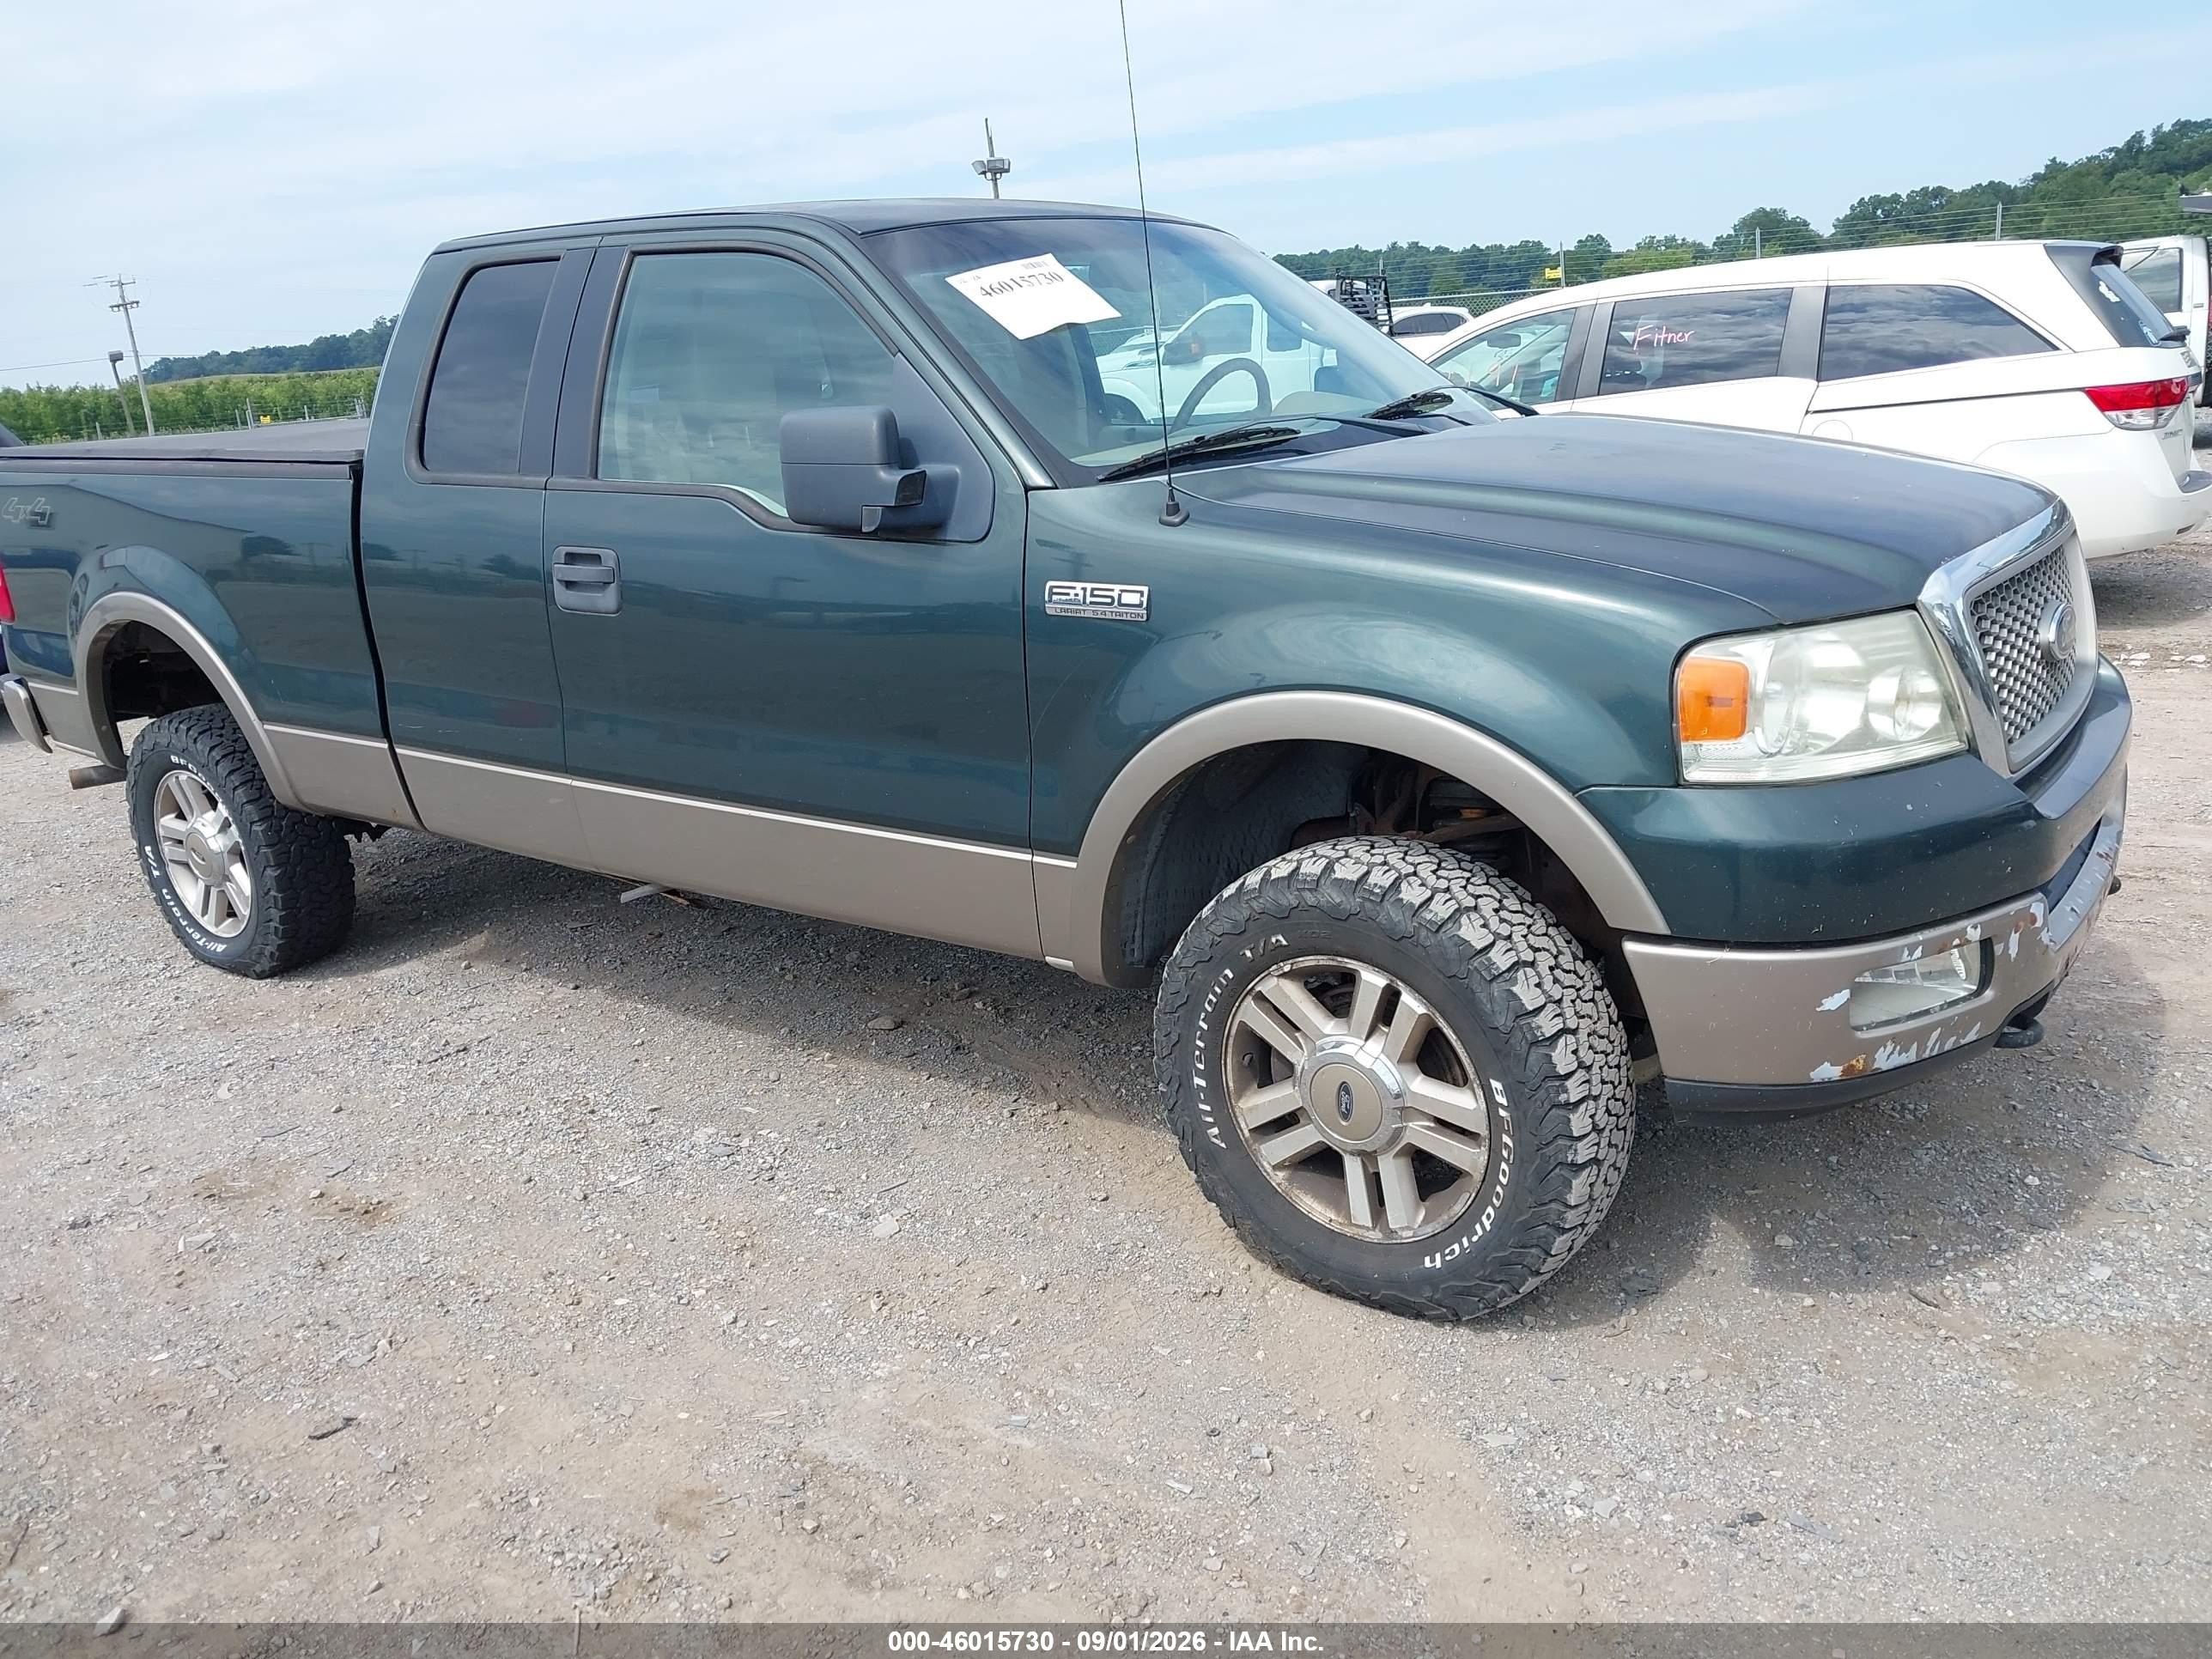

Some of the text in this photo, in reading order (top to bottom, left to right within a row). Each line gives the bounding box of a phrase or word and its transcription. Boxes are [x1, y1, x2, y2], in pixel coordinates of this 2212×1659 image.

[980, 271, 1064, 297] 46015730
[1633, 325, 1695, 351] Fitner
[1048, 585, 1145, 609] F-150
[1109, 611, 1145, 619] TRITON
[1192, 967, 1235, 1150] All-Terrain
[1238, 933, 1290, 962] T/A
[1423, 1079, 1515, 1270] BFGoodrich
